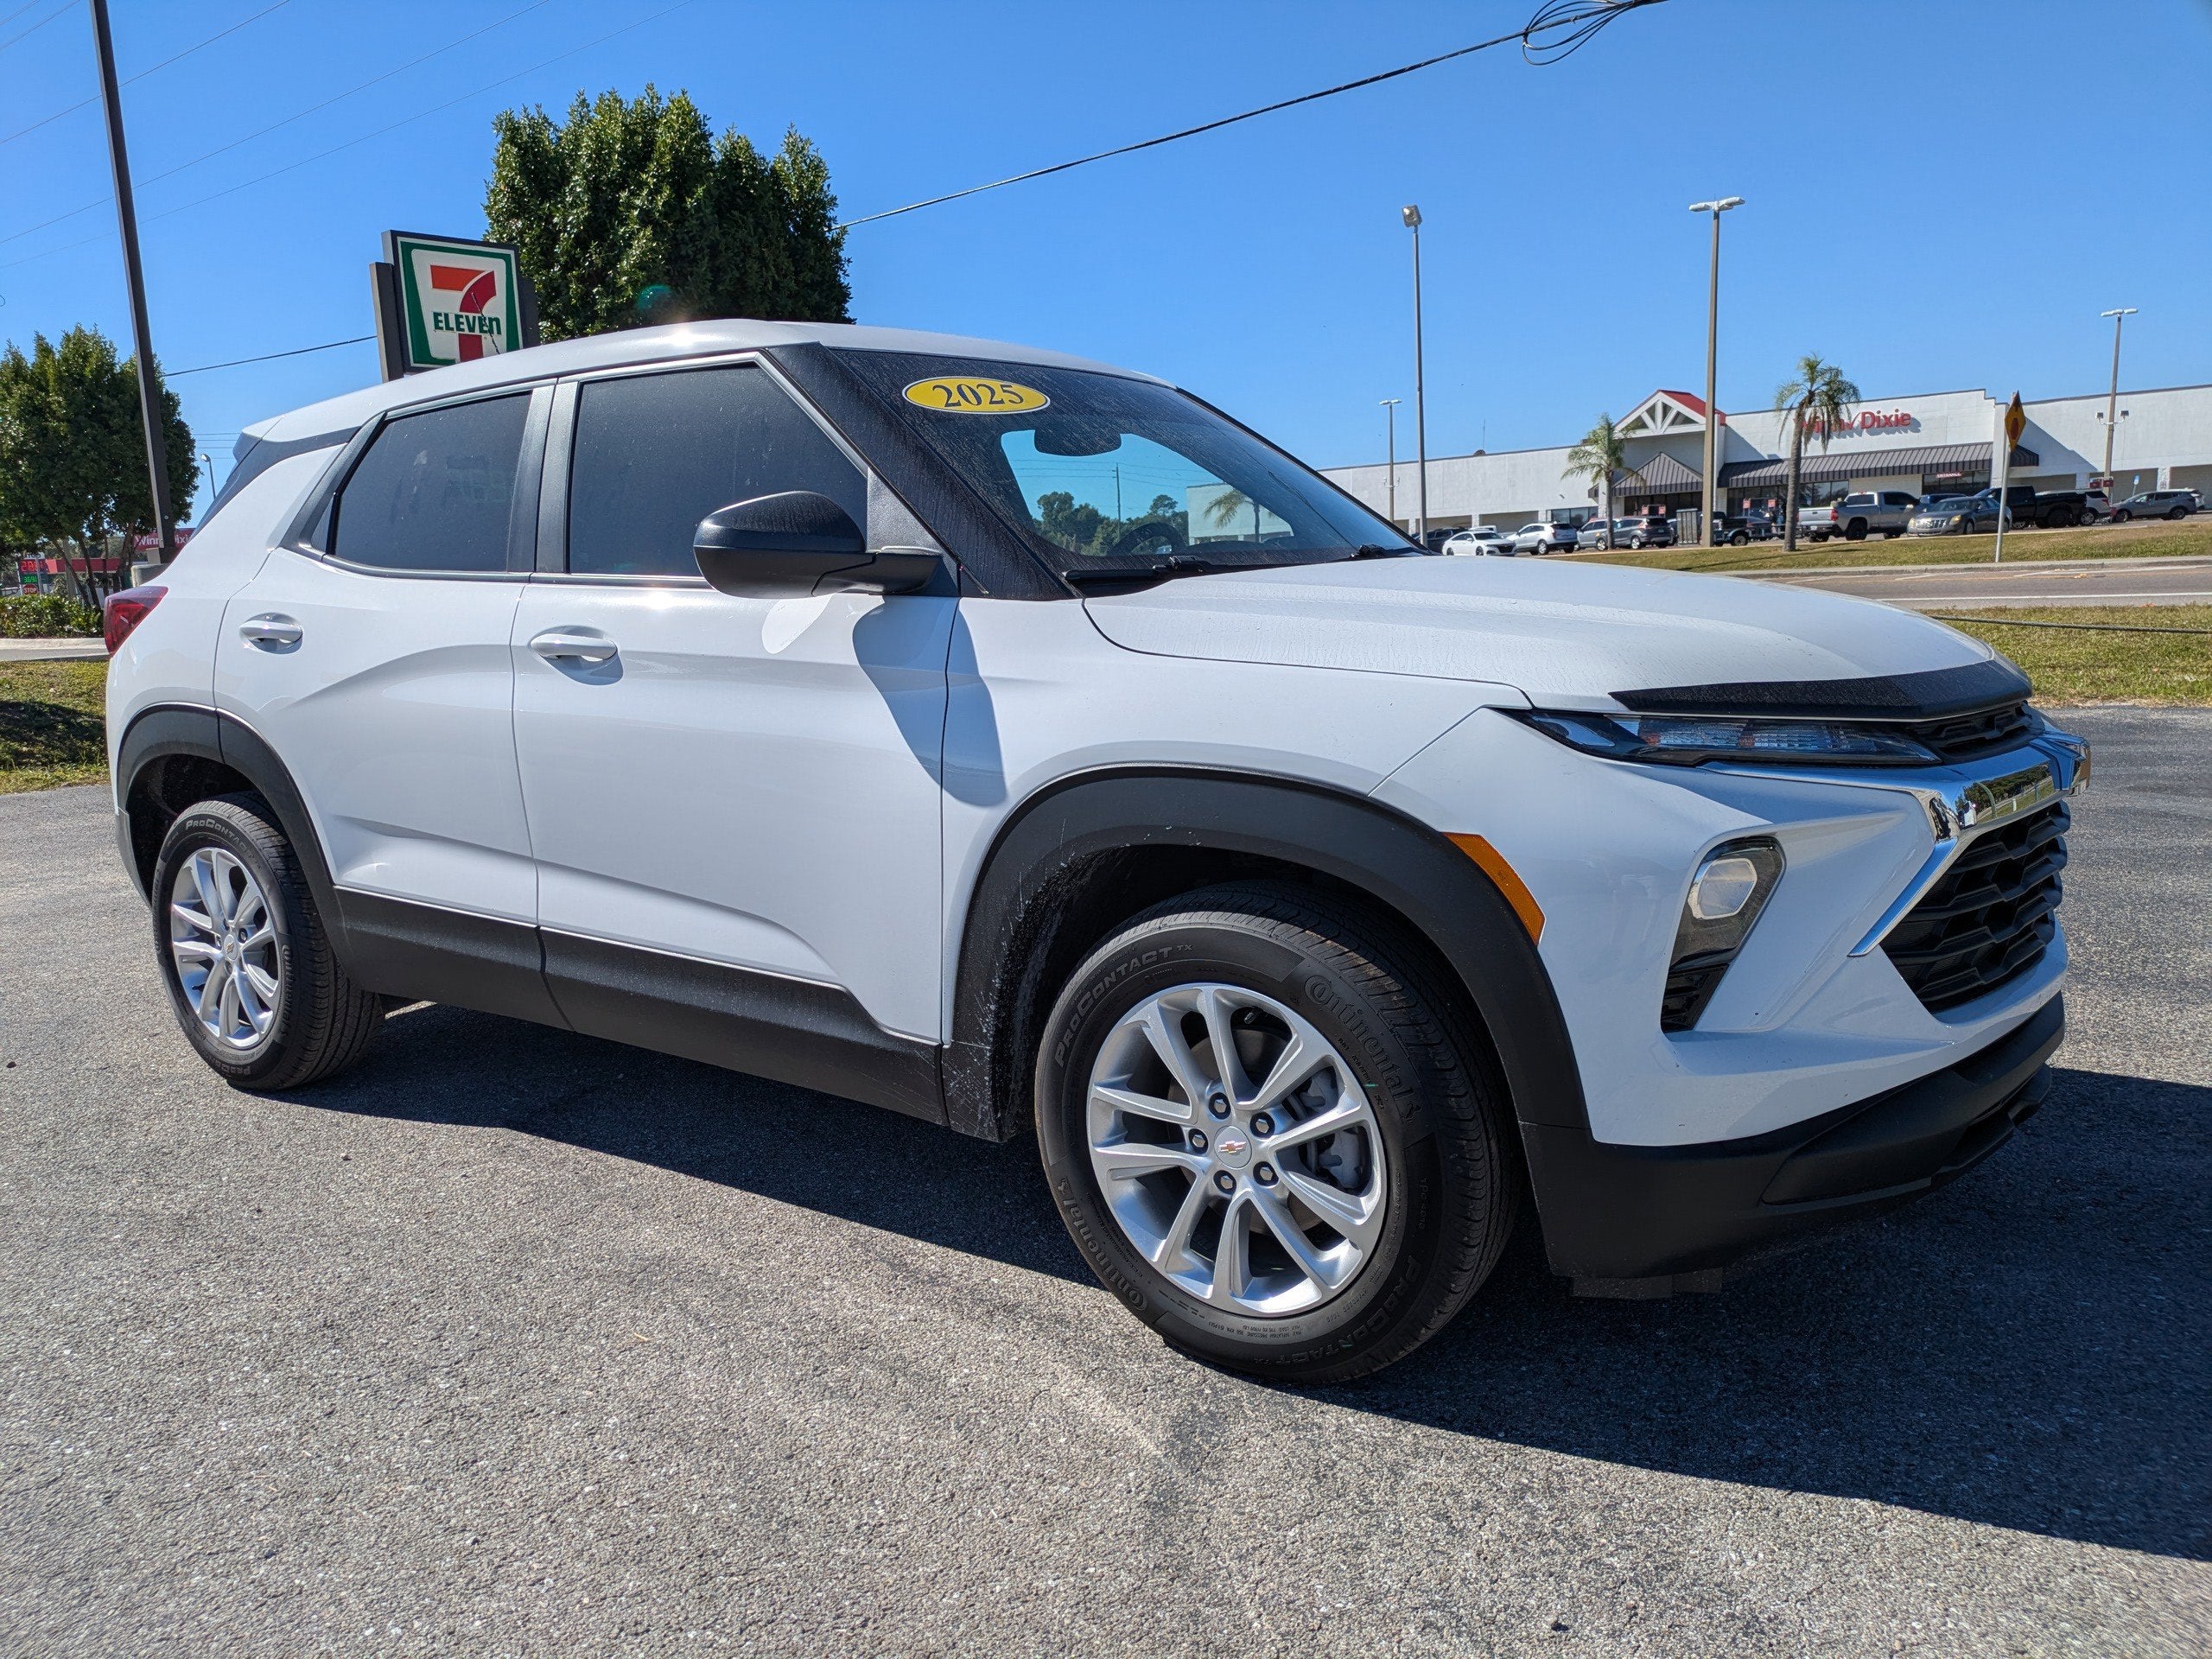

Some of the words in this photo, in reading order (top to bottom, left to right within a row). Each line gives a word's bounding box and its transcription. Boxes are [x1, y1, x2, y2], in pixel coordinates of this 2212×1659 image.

[430, 265, 497, 362] 7
[932, 384, 1024, 408] 2025
[1860, 409, 1911, 429] Dixie
[1304, 975, 1415, 1101] Continental
[1063, 1197, 1148, 1311] Continental
